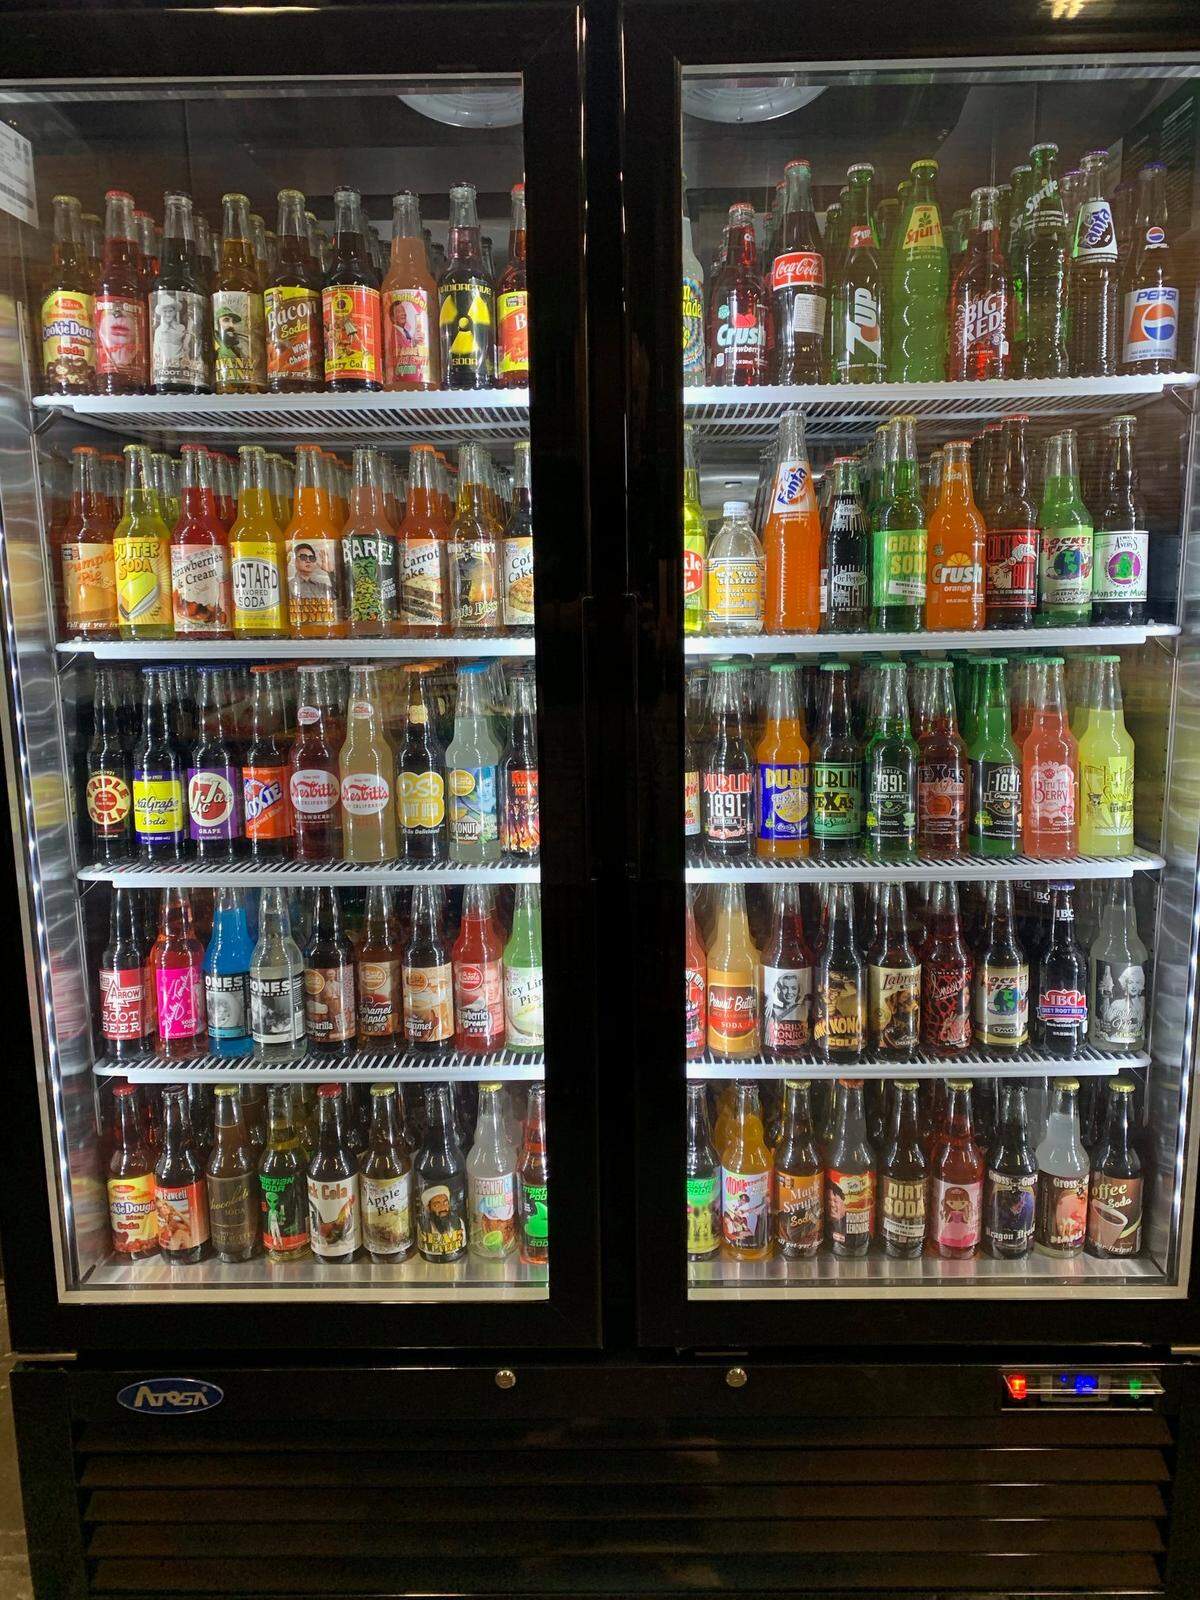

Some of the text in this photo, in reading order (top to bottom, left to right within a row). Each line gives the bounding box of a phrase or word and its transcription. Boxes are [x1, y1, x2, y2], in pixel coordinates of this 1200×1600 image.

[1026, 180, 1058, 215] Sprite
[905, 226, 942, 244] Squirt
[1084, 208, 1109, 247] Fanta
[1137, 289, 1177, 303] PEPSI
[966, 290, 1004, 327] BIG
[281, 318, 310, 340] Soda
[717, 324, 766, 346] Crush
[964, 311, 1002, 344] RED
[777, 467, 807, 504] Fanta
[114, 541, 160, 558] BUTTER
[341, 539, 394, 563] BARF!
[402, 547, 440, 569] Carrot
[118, 558, 154, 580] SODA
[185, 568, 218, 585] Cream
[232, 562, 278, 588] USTARD
[932, 564, 982, 583] Crush
[944, 585, 972, 593] orange
[239, 596, 266, 607] SODA
[86, 777, 130, 799] TRIPLE
[290, 781, 338, 798] Nesbitt's
[876, 774, 903, 792] 1891
[994, 773, 1020, 791] 1891
[342, 783, 389, 801] Nesbitt's
[709, 793, 741, 817] 1891
[142, 817, 167, 826] Soda
[1056, 909, 1074, 918] IBC
[1050, 996, 1079, 1006] IBC
[103, 1010, 139, 1022] ROOT
[721, 1021, 743, 1029] SODA
[102, 1022, 142, 1033] BEER
[776, 1021, 808, 1031] ARILY
[776, 1031, 808, 1040] ONRO
[321, 1184, 348, 1200] Cola
[367, 1188, 400, 1207] Apple
[888, 1183, 923, 1200] DIRT
[377, 1204, 395, 1216] Pie
[883, 1197, 926, 1217] SODA
[1107, 1195, 1133, 1209] Soda
